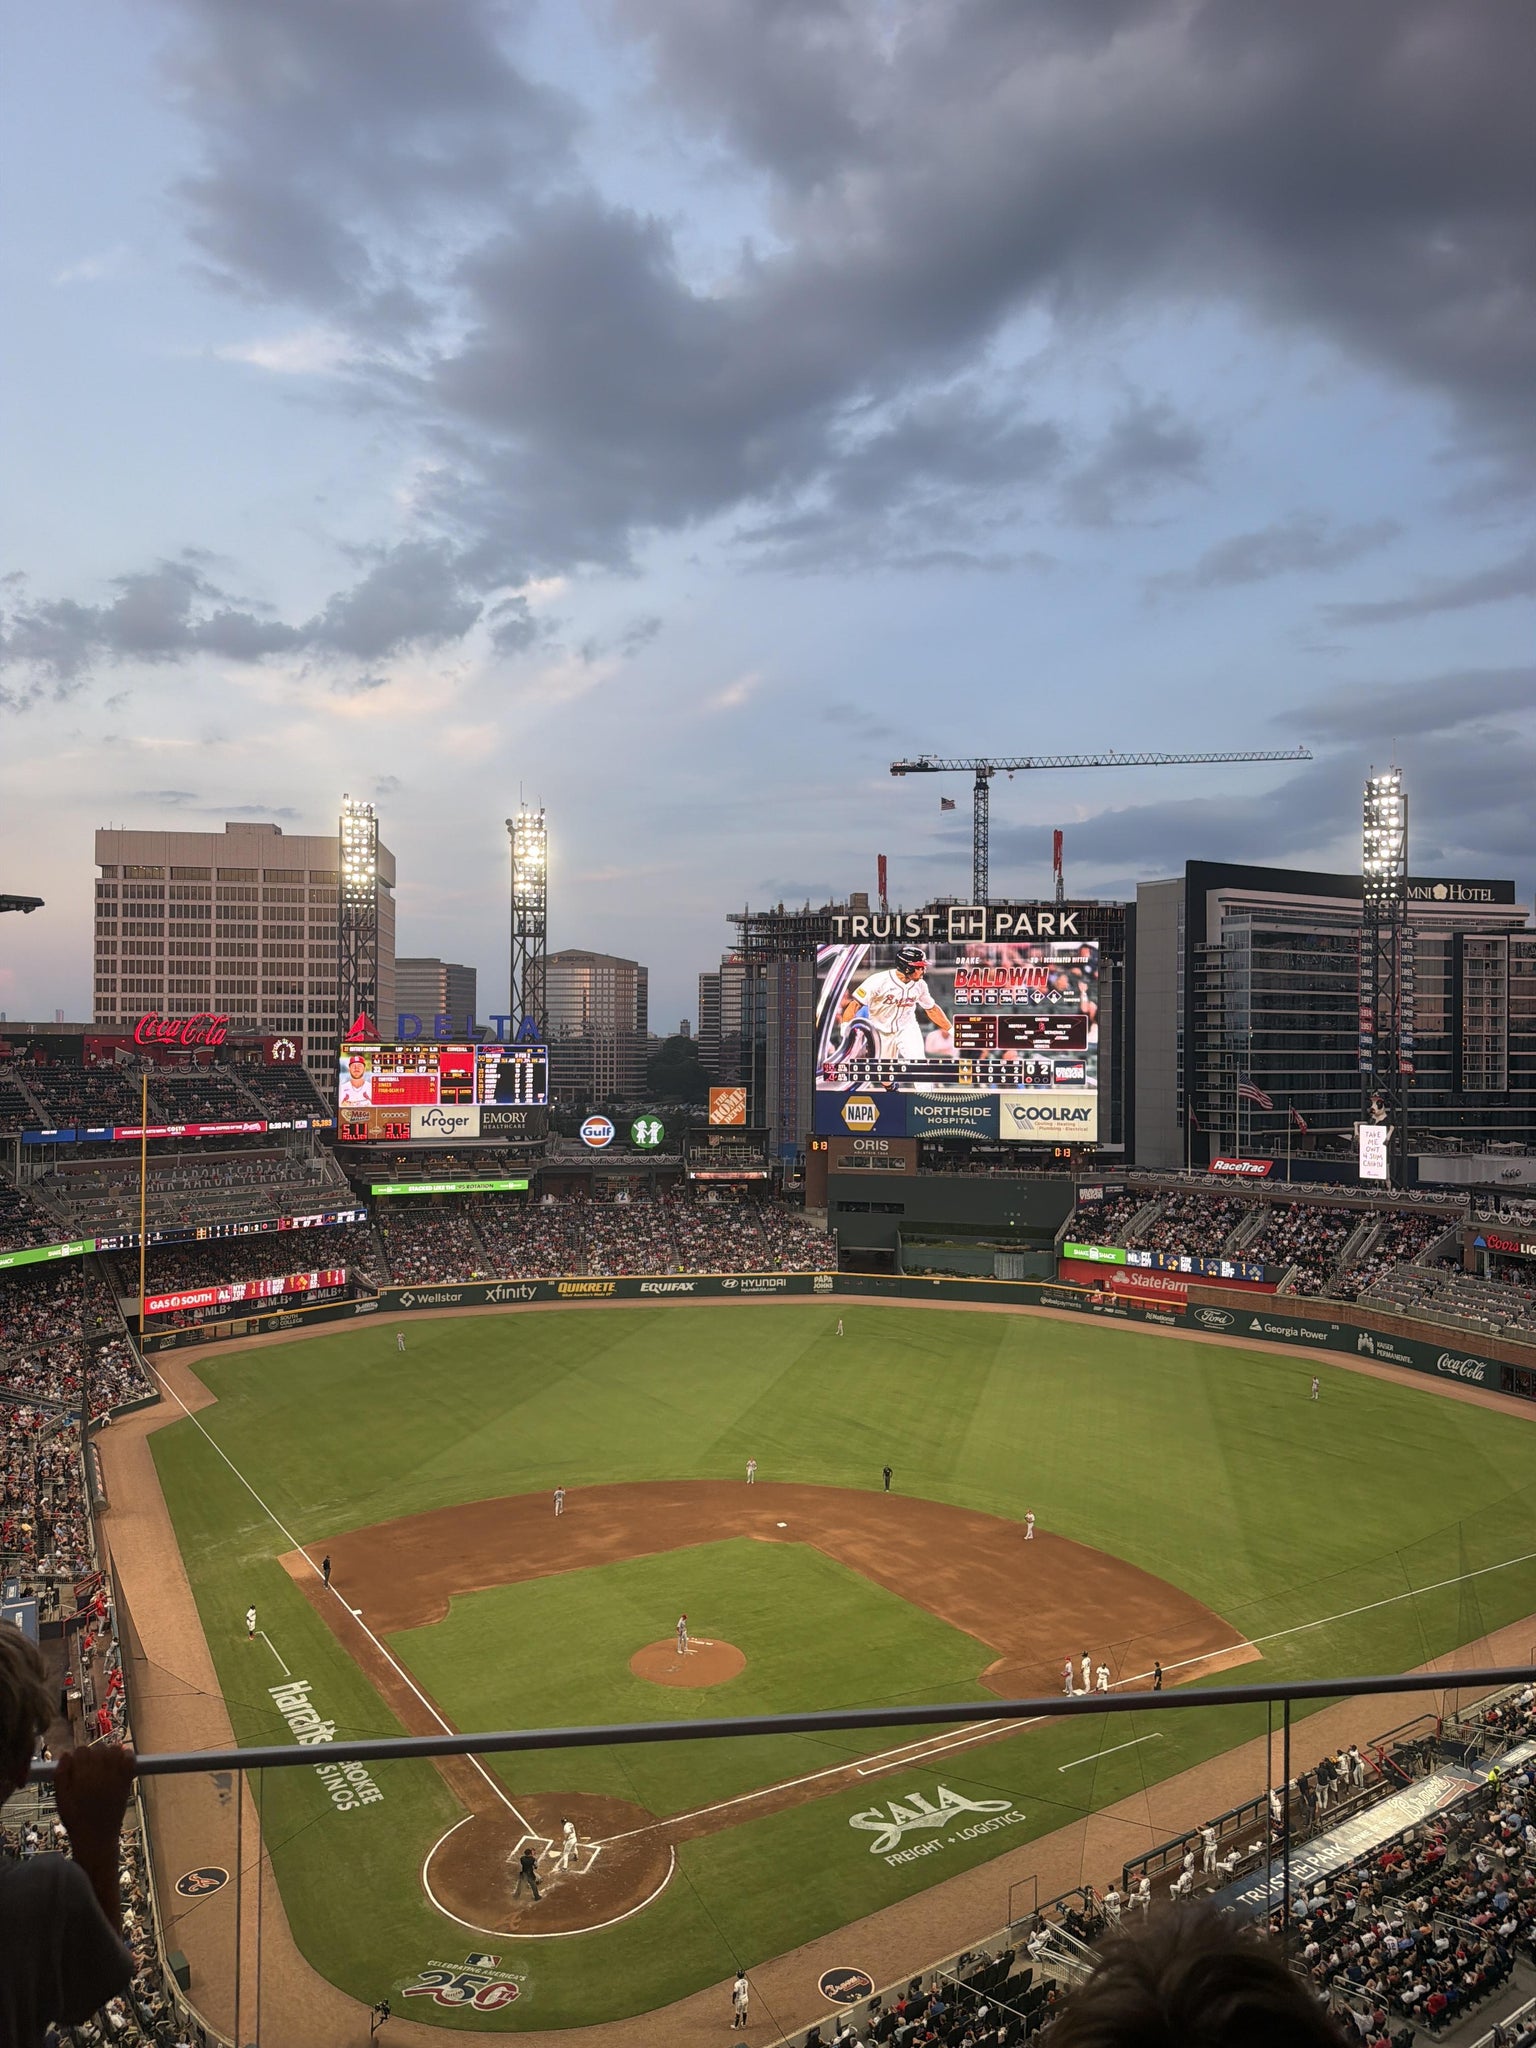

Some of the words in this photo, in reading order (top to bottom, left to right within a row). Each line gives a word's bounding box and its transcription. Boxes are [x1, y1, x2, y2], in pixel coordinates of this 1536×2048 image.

[1449, 884, 1495, 902] HOTEL
[832, 914, 941, 938] TRUIST
[996, 912, 1080, 936] PARK
[954, 967, 1049, 987] BALDWIN
[134, 1011, 231, 1046] Coca-Cola
[397, 1013, 541, 1041] DELTA
[1027, 1065, 1035, 1074] 0
[1041, 1065, 1048, 1075] 2
[711, 1088, 746, 1124] HOME
[714, 1092, 729, 1106] THE
[483, 1112, 528, 1124] EMORY
[724, 1101, 746, 1124] DEPOT
[848, 1106, 873, 1121] NAPA
[914, 1106, 991, 1117] NORTHSIDE
[1013, 1107, 1092, 1121] COOLRAY
[421, 1109, 470, 1135] Kroger
[928, 1117, 977, 1125] HOSPITAL
[343, 1123, 368, 1135] 511
[386, 1123, 410, 1135] 375
[583, 1126, 612, 1136] Gulf
[854, 1139, 889, 1151] ORIS
[1214, 1160, 1265, 1172] RaceTrac
[1487, 1235, 1519, 1252] Coors
[1128, 1253, 1139, 1262] NL
[741, 1279, 786, 1287] HYUNDAI
[814, 1275, 833, 1283] PAPA
[1130, 1273, 1161, 1288] State
[218, 1290, 230, 1299] AL
[317, 1288, 342, 1298] MLB+
[485, 1284, 537, 1302] xfinity
[557, 1282, 616, 1293] QUIKRETE
[640, 1282, 696, 1293] EQUIFAX
[150, 1299, 170, 1310] GAS
[181, 1293, 212, 1305] SOUTH
[417, 1292, 462, 1304] Wellstar
[205, 1305, 232, 1317] MLB+
[1152, 1314, 1175, 1322] National
[1201, 1310, 1228, 1324] Ford
[1264, 1323, 1298, 1337] Georgia
[1300, 1328, 1328, 1340] Power
[1377, 1341, 1394, 1352] KAISER
[1377, 1349, 1411, 1363] PERMANENTE
[1437, 1353, 1487, 1380] Coca-Cola
[849, 1785, 1013, 1854] SAIA
[884, 1839, 945, 1867] FREIGHT
[956, 1810, 1026, 1840] LOGISTICS
[1236, 1870, 1294, 1906] TRUIST
[1308, 1843, 1350, 1868] PARK
[427, 1960, 481, 1973] CELEBRATING
[482, 1969, 526, 1981] AMERICA'S
